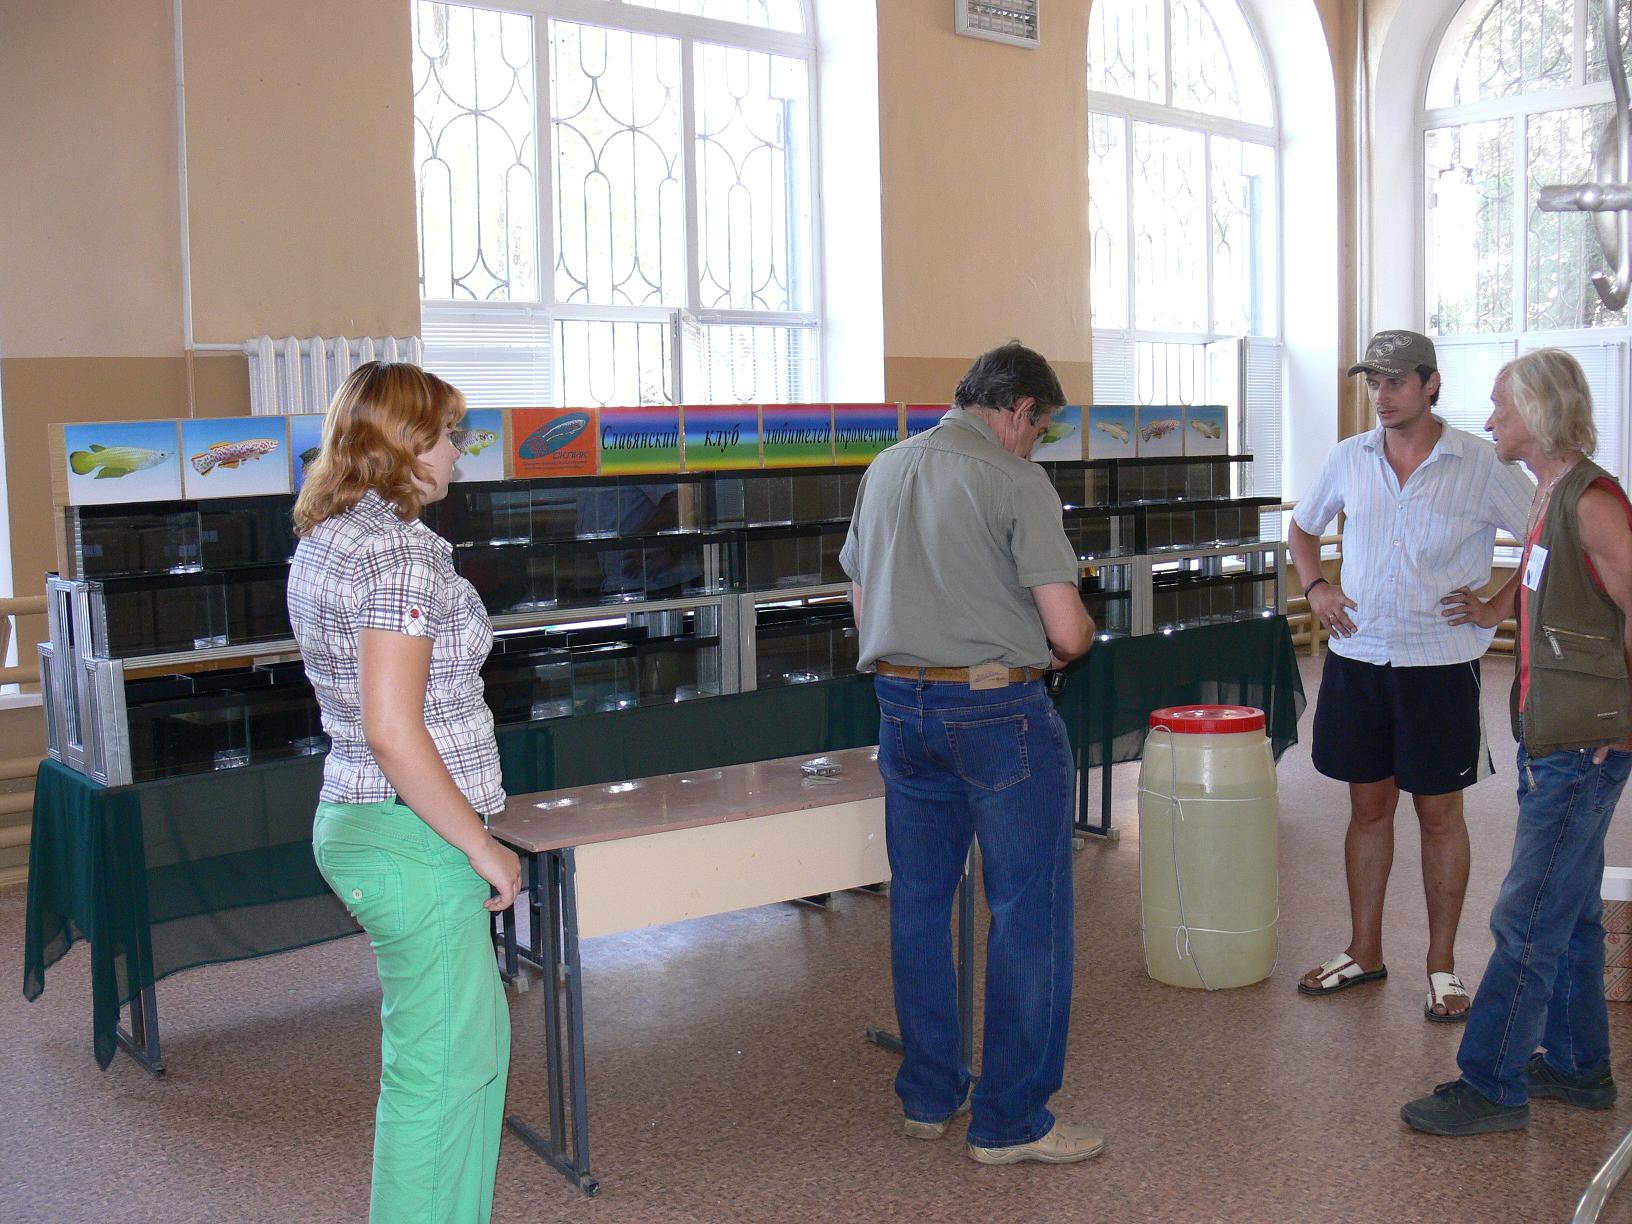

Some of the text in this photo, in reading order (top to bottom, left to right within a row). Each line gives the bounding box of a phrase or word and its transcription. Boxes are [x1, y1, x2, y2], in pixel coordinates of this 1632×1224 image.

[601, 424, 679, 450] Славянский
[704, 423, 742, 452] клуб
[763, 422, 831, 445] любителей
[834, 426, 899, 449] икромечущих
